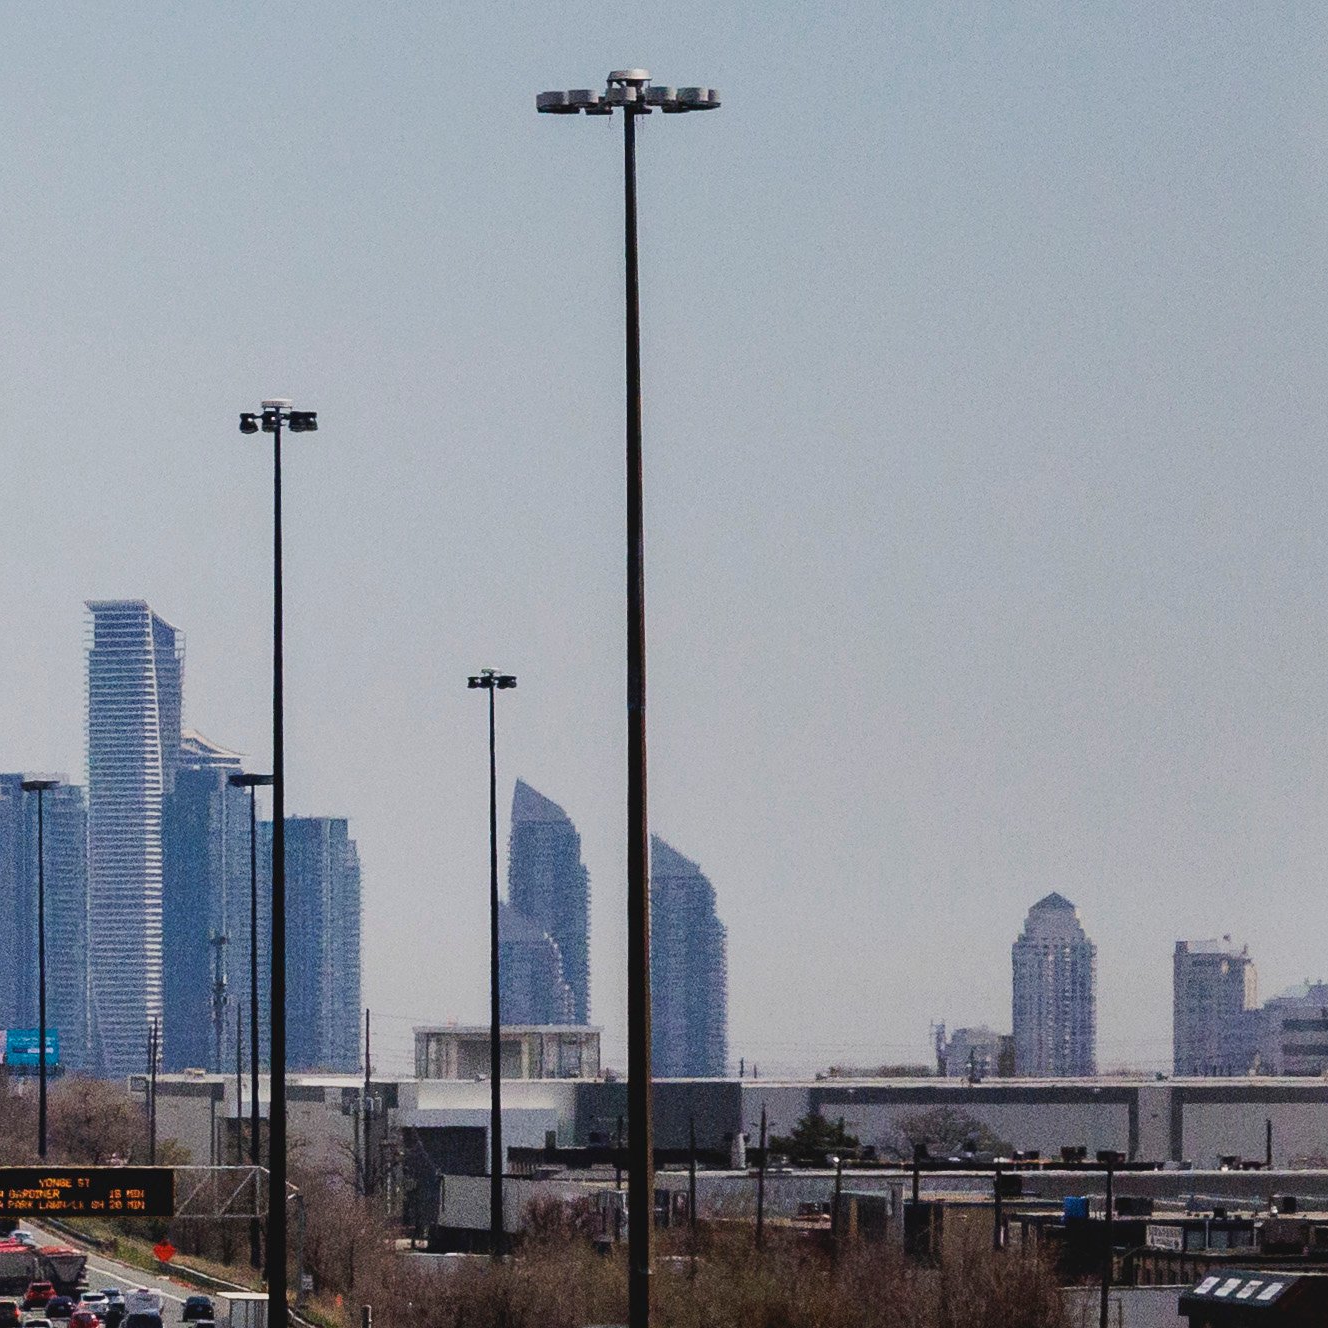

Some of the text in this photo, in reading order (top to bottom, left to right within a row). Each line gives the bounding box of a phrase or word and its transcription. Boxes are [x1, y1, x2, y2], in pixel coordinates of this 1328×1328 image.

[39, 1178, 90, 1188] YONGE ST
[126, 1189, 145, 1199] MIN
[126, 1200, 146, 1210] MIN
